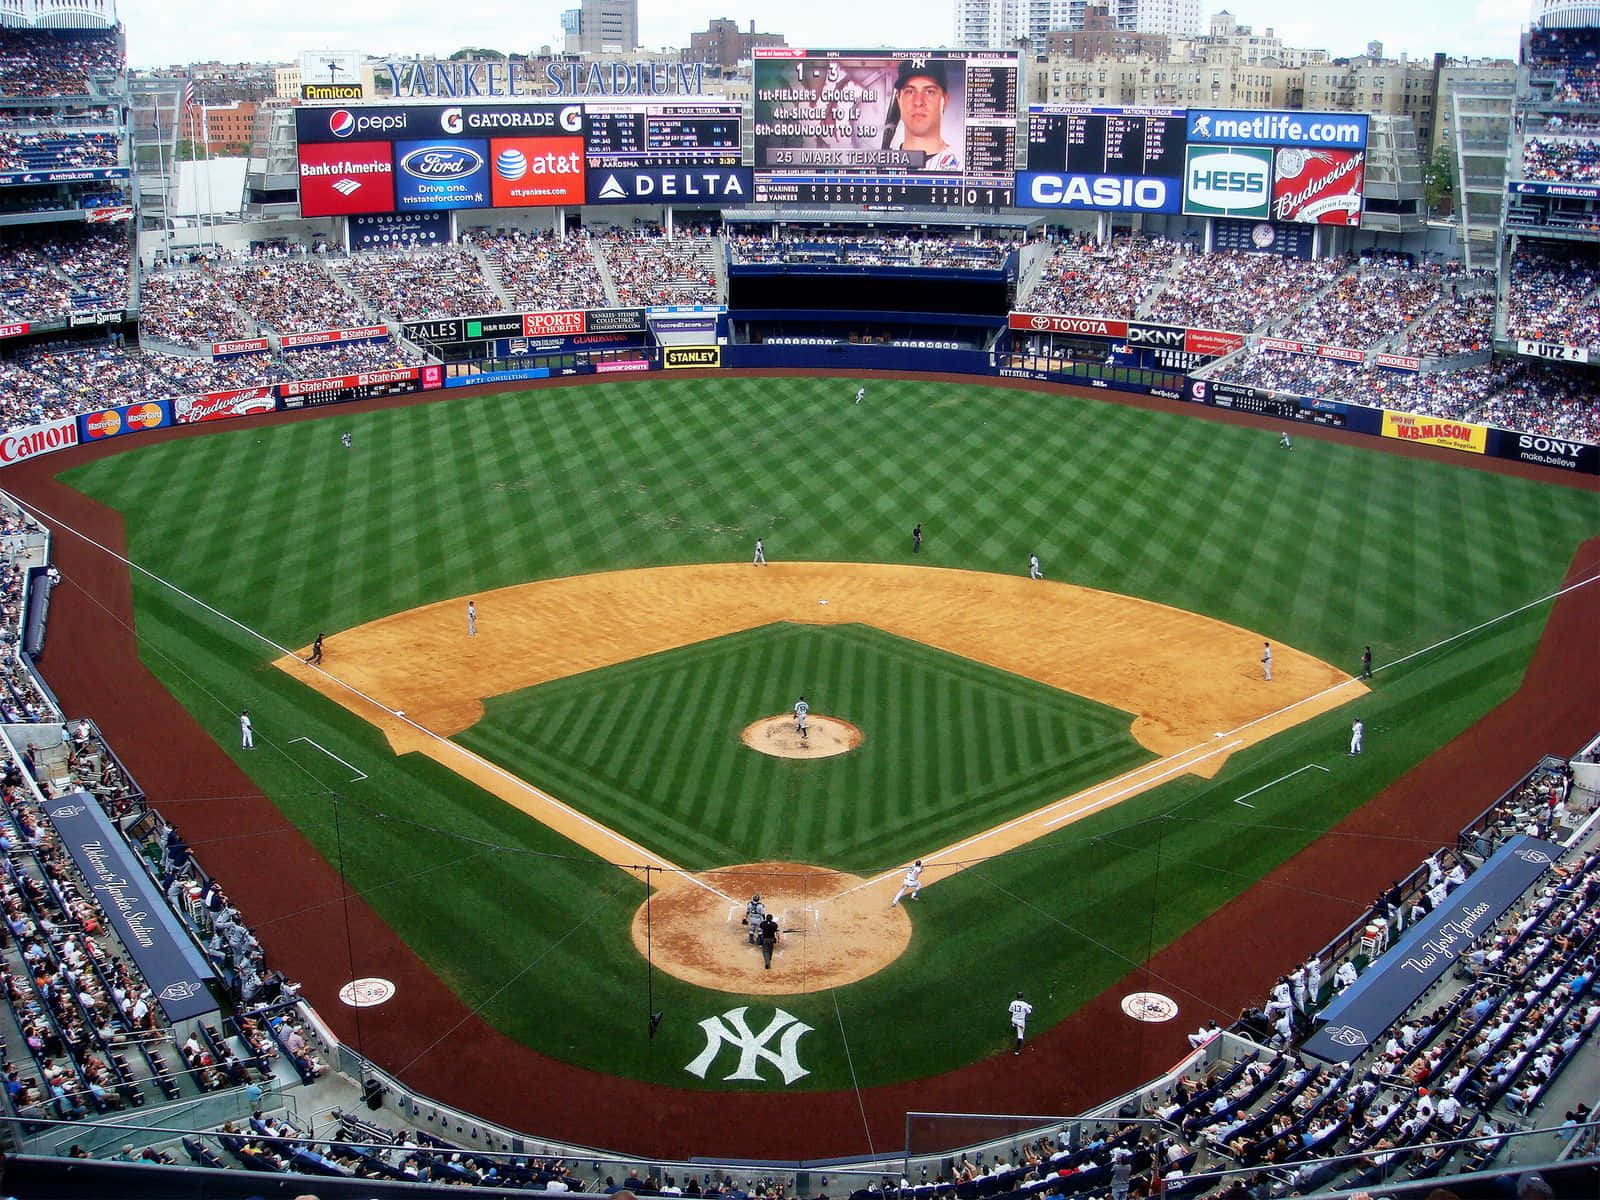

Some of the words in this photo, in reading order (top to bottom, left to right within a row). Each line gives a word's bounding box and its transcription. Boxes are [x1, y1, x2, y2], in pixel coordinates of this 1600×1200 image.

[386, 63, 526, 97] YANKEE
[546, 63, 704, 97] STADIUM
[797, 63, 804, 81] 1
[828, 63, 839, 81] 3
[306, 86, 362, 99] Armitron
[862, 91, 878, 103] RBI
[468, 111, 556, 129] GATORADE
[774, 108, 827, 120] 4th-SINGLE
[829, 109, 844, 120] TO
[847, 109, 860, 120] LF
[358, 113, 408, 133] pepsi
[1214, 116, 1361, 144] metlife.com
[755, 125, 837, 138] 6th-GROUNDOUT
[839, 126, 853, 138] TO
[857, 126, 877, 138] 3RD
[420, 153, 464, 174] Ford
[532, 150, 581, 175] at&t
[777, 152, 793, 165] 25
[801, 151, 843, 166] MARK
[845, 151, 911, 167] TEIXEIRA
[49, 172, 94, 181] Amtrak.com
[301, 163, 335, 177] Bank
[332, 162, 345, 175] of
[345, 160, 392, 175] America
[418, 184, 446, 193] Drive
[447, 184, 468, 193] one.
[635, 172, 744, 197] DELTA
[1193, 169, 1264, 194] HESS
[1272, 151, 1365, 220] Budweiser
[403, 193, 475, 204] tristateford.com
[510, 187, 567, 198] att.yankees.com
[967, 190, 977, 203] 0
[985, 190, 993, 204] 1
[1003, 191, 1010, 205] 1
[1030, 175, 1167, 208] CASIO
[1546, 186, 1598, 198] Amtrak.com
[71, 315, 97, 328] Poland
[97, 311, 122, 325] Spring
[483, 324, 498, 332] H&R
[498, 322, 521, 331] BLOCK
[527, 313, 582, 328] SPORTS
[1052, 319, 1109, 335] TOYOTA
[409, 322, 457, 341] ZALES
[528, 324, 582, 336] AUTHORITY
[1128, 328, 1185, 346] DKNY
[669, 352, 715, 362] STANLEY
[1112, 344, 1134, 355] FedEx
[1154, 350, 1201, 362] SHARPER
[1322, 347, 1361, 361] MODELL'S
[1538, 344, 1565, 360] UTZ
[1161, 358, 1193, 369] IMAGE
[1378, 356, 1418, 369] MODELL'S
[487, 374, 529, 384] CONSULTING
[189, 388, 259, 422] Budweiser
[88, 417, 121, 431] MasterCard
[127, 410, 162, 424] MasterCard
[1397, 423, 1472, 443] W.B.MASON
[0, 422, 77, 463] Canon
[1437, 438, 1453, 447] Office
[1453, 440, 1477, 450] Supplies
[1519, 435, 1585, 457] SONY
[1520, 451, 1577, 469] make.believe
[81, 840, 110, 879] Welcome
[122, 910, 155, 949] Stadium
[1400, 952, 1437, 974] New
[1421, 928, 1458, 960] York
[1443, 902, 1491, 939] Yankees
[1013, 1004, 1023, 1013] 13
[683, 1005, 817, 1087] NY
